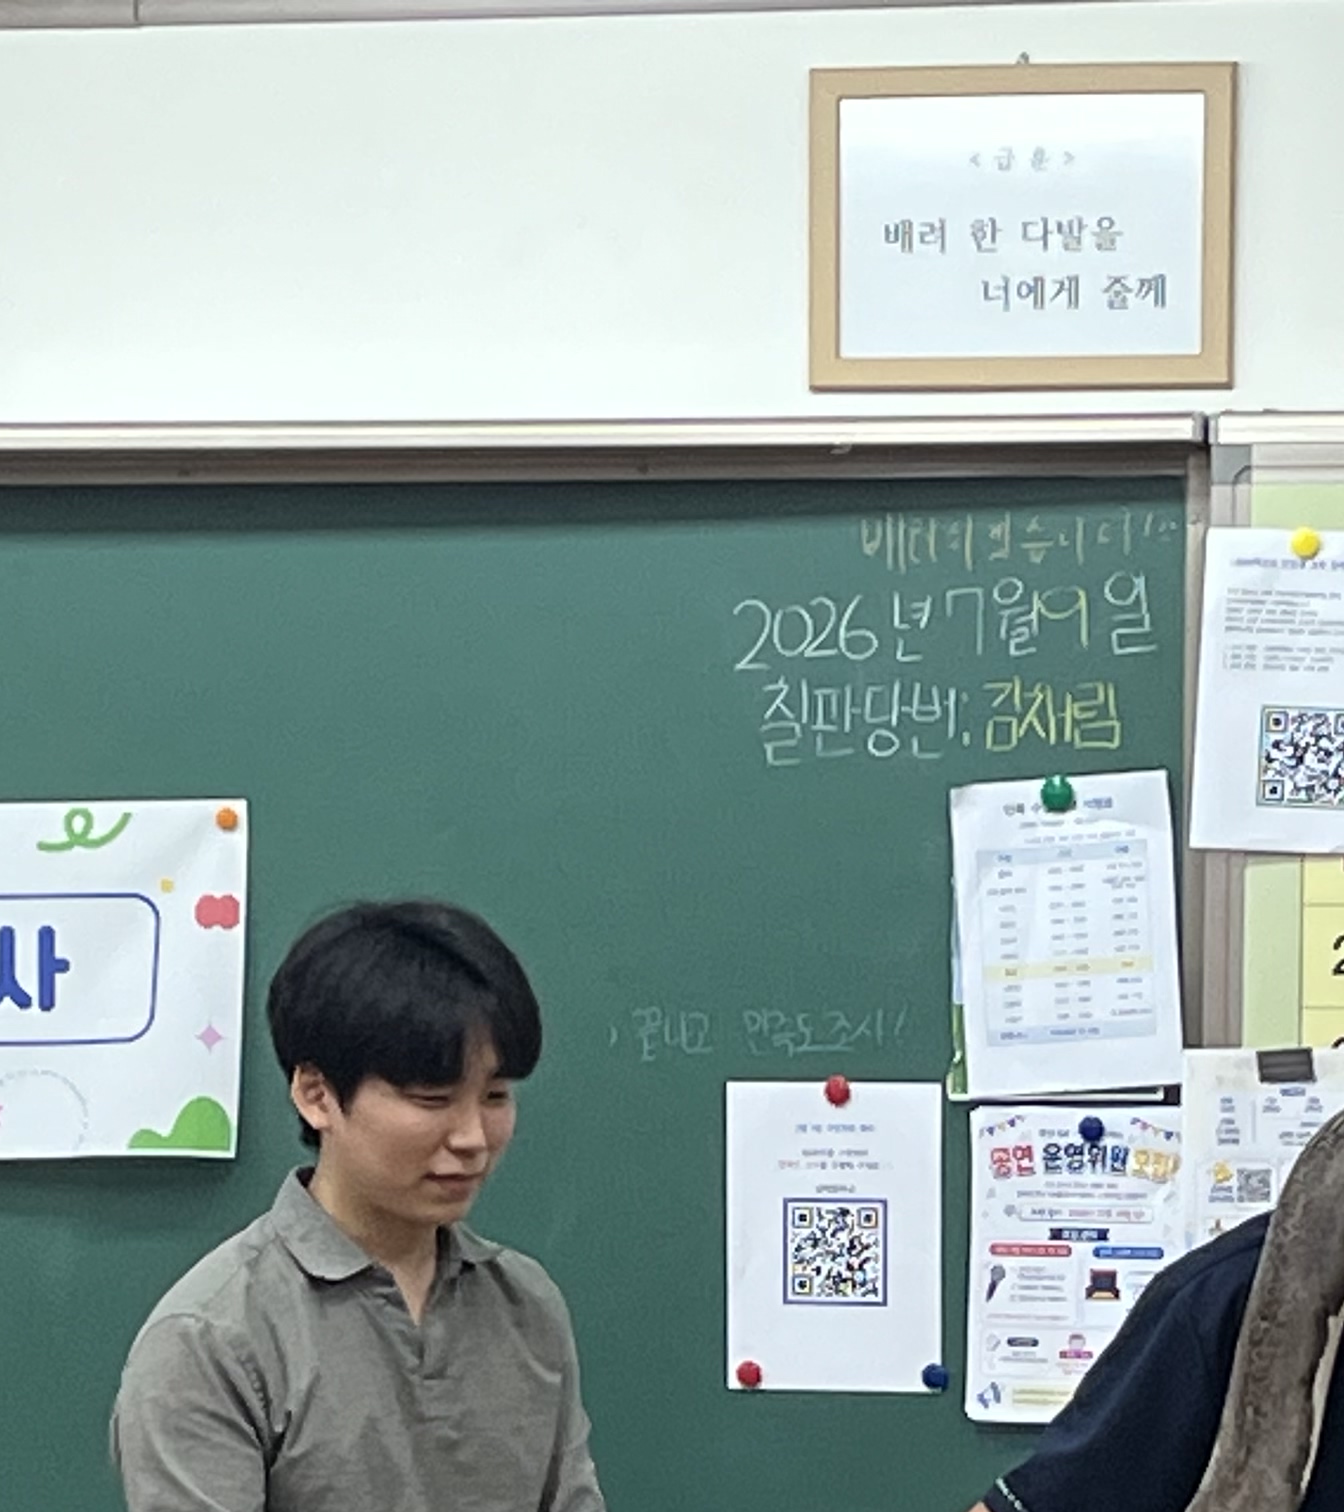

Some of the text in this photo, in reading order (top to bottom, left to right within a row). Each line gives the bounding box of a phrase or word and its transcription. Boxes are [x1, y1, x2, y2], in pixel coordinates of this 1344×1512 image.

[883, 215, 1124, 254] 배려 한 다발을
[981, 272, 1168, 312] 너에게 줄께
